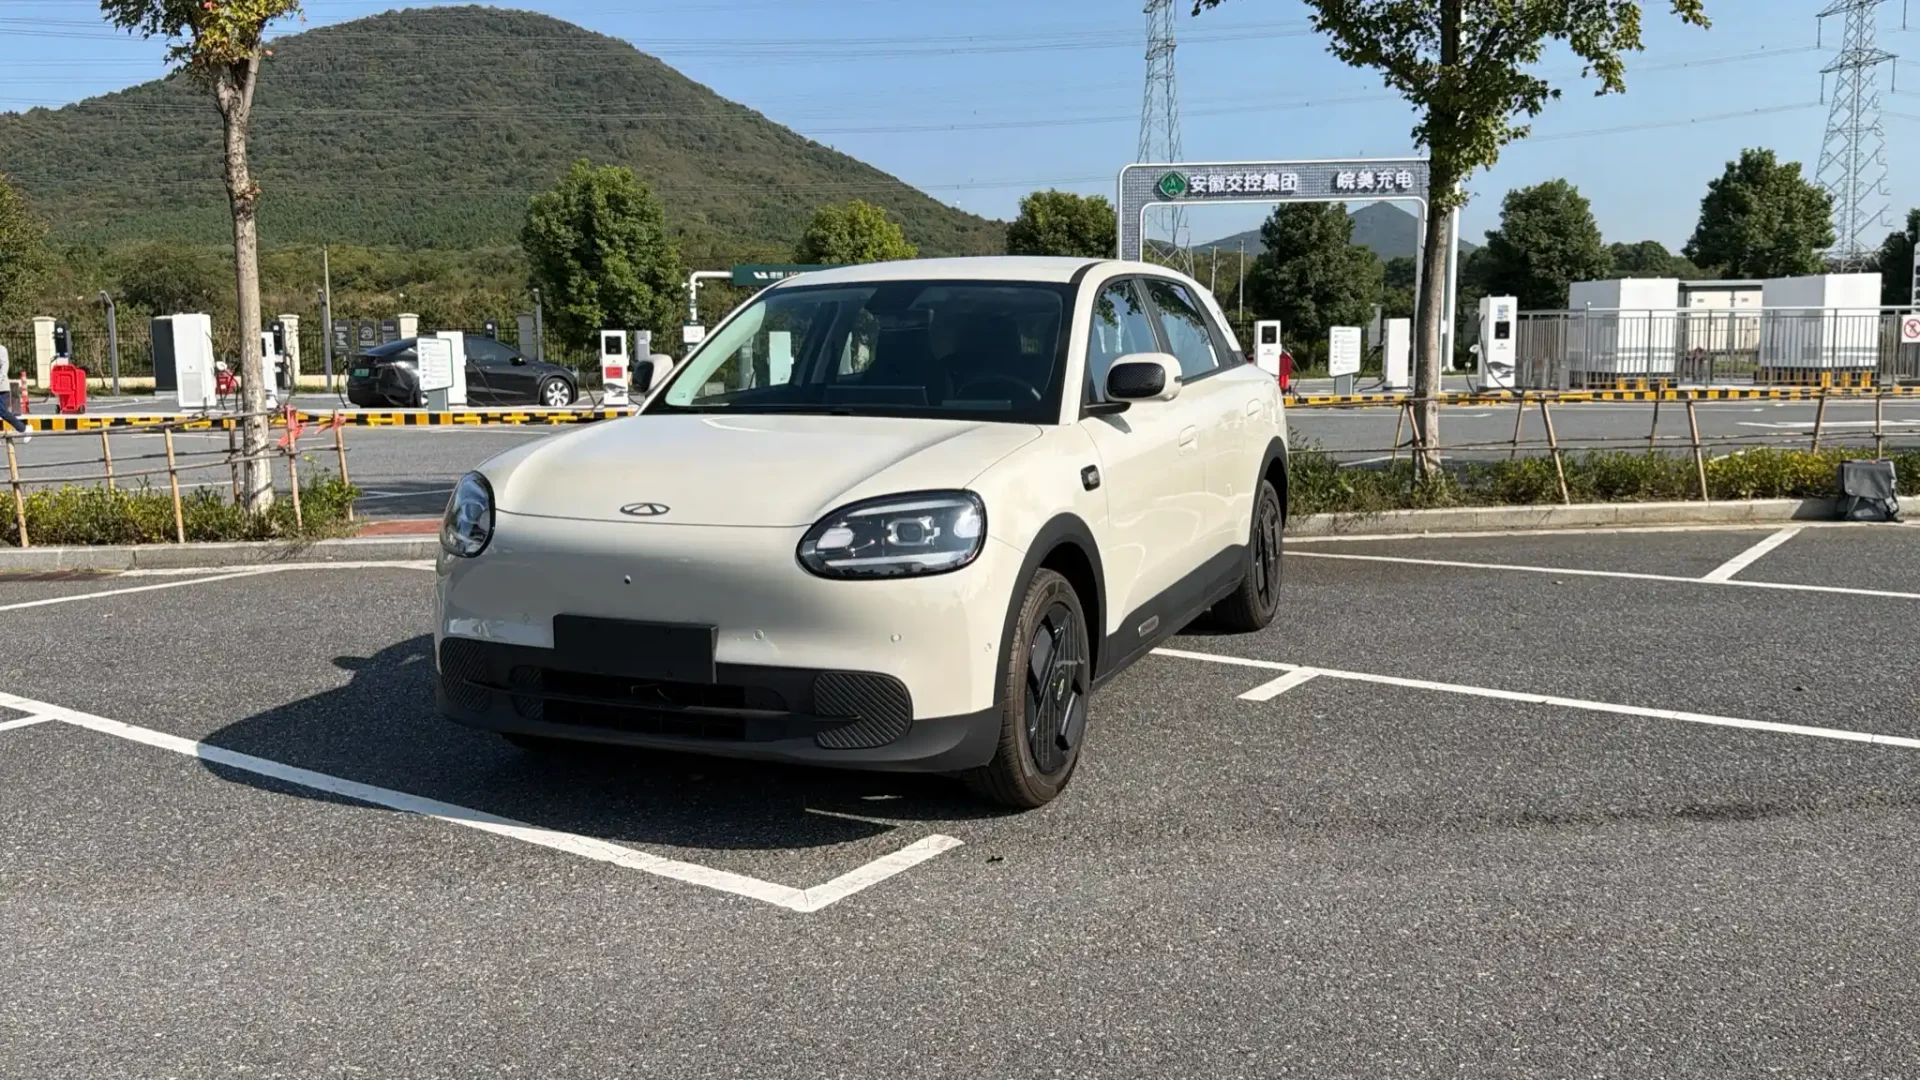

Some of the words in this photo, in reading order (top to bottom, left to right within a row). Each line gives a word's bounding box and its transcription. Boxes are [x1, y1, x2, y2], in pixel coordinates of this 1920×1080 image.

[1190, 173, 1298, 192] 安徽交控集团
[1337, 170, 1413, 189] 皖美充电
